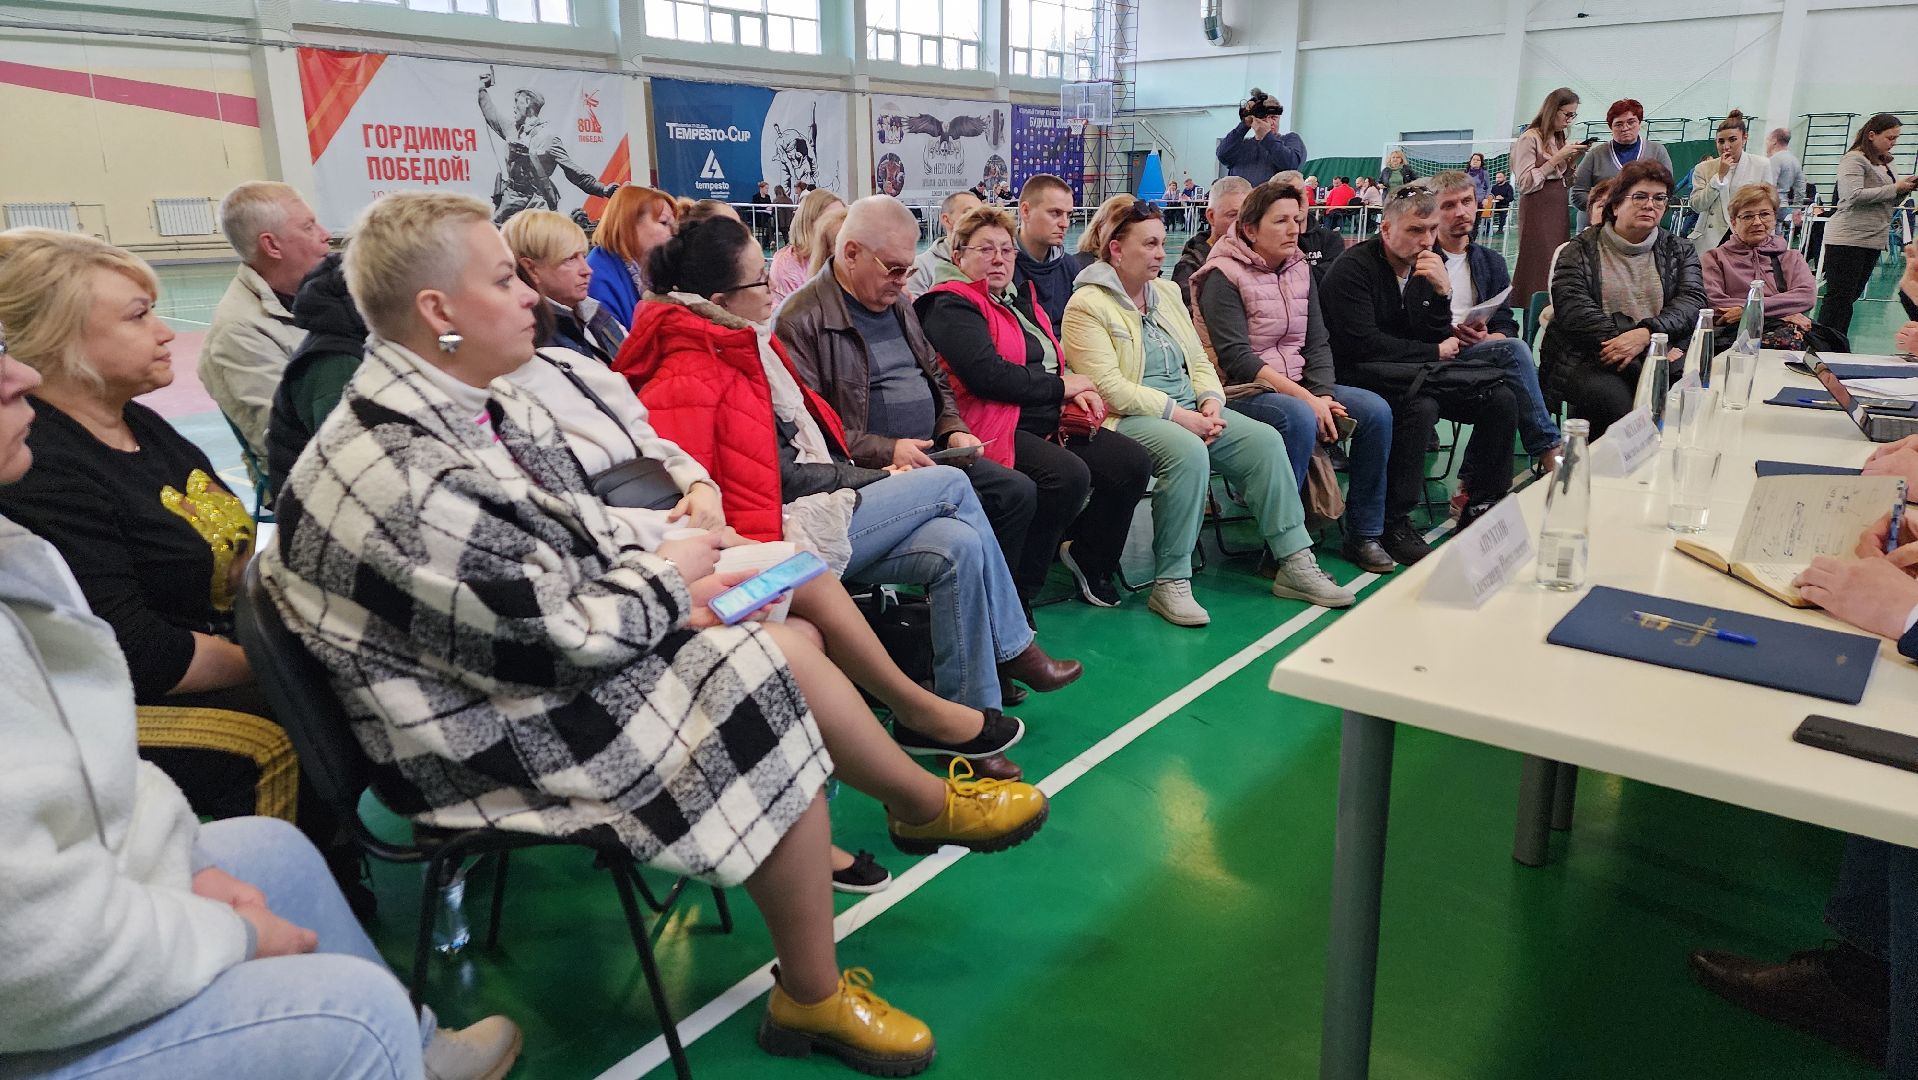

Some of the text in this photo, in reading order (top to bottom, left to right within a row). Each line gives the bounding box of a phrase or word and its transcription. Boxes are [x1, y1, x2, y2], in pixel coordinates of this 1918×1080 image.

[577, 118, 591, 133] 80
[362, 123, 478, 154] ГОРДИМСЯ
[366, 155, 471, 186] ПОБЕДОЙ!
[694, 181, 730, 191] tempesto
